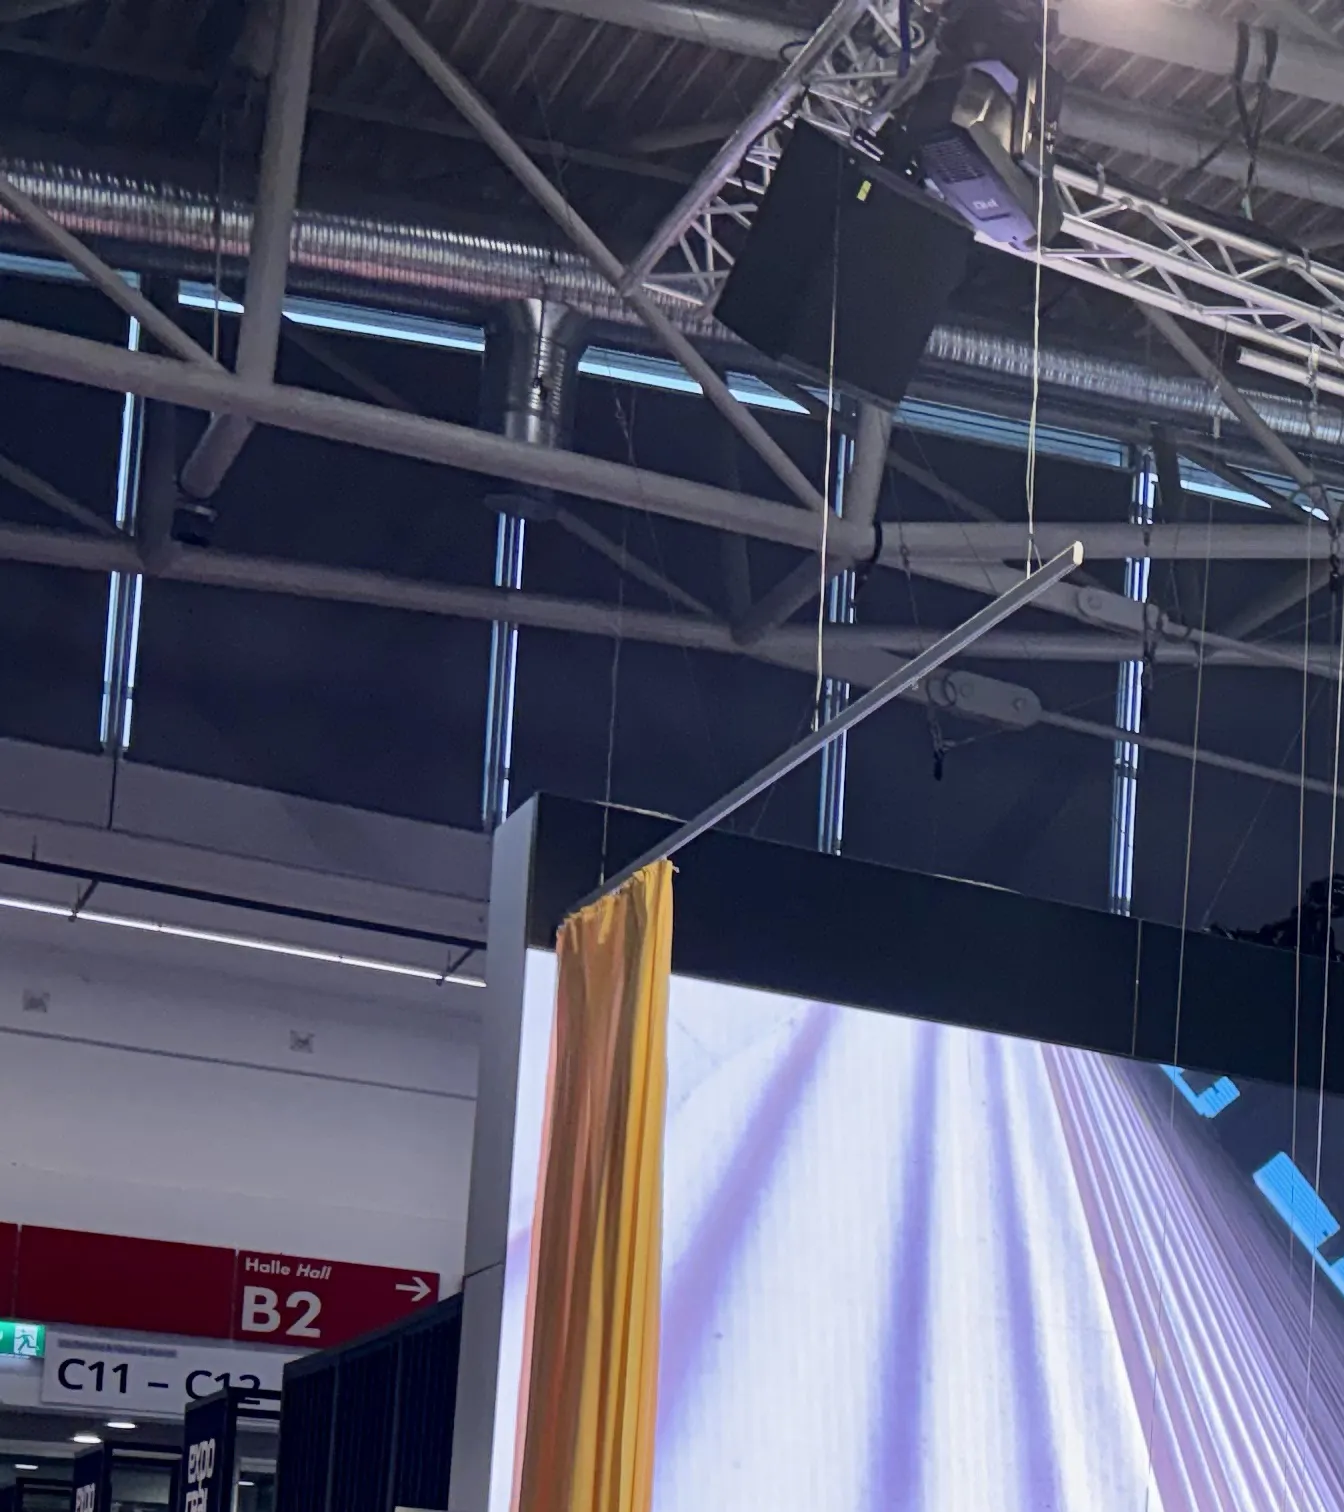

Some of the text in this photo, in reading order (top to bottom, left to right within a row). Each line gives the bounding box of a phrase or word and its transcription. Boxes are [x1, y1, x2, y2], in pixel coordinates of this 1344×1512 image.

[245, 1257, 331, 1280] Halle Hall
[241, 1285, 322, 1338] B2
[58, 1358, 129, 1394] C11
[187, 1438, 216, 1489] expo
